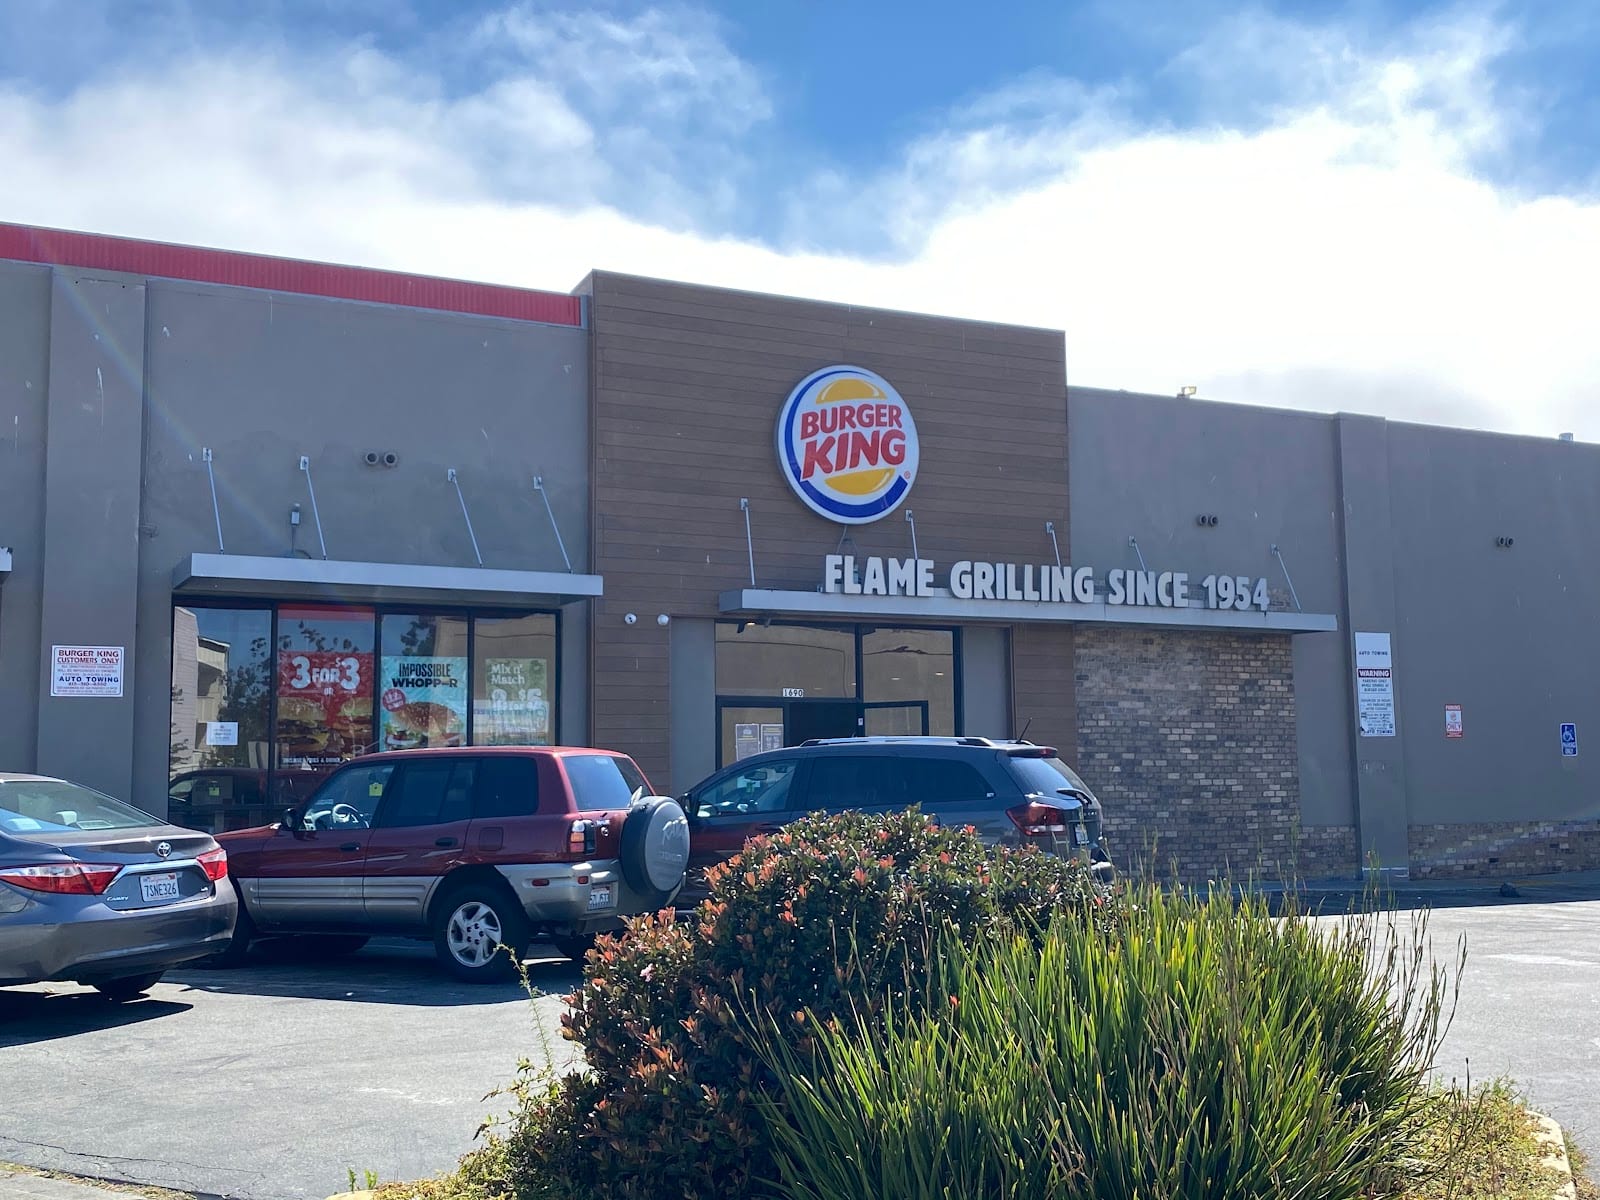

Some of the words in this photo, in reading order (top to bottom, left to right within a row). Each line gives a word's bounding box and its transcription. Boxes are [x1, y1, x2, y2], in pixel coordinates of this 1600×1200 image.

[800, 404, 903, 440] BURGER
[802, 429, 906, 480] KING
[825, 554, 934, 597] FLAME
[950, 561, 1094, 603] GRILLING
[1108, 568, 1189, 608] SINCE
[1201, 574, 1270, 611] 1954
[58, 649, 94, 657] BURGER
[97, 650, 119, 658] KING
[291, 655, 311, 688] 3
[312, 667, 340, 683] FOR
[399, 663, 451, 677] IMPOSSIBLE
[491, 663, 511, 674] Mix
[491, 674, 525, 685] Match
[784, 689, 803, 697] 1690
[144, 882, 177, 897] 7SNE326
